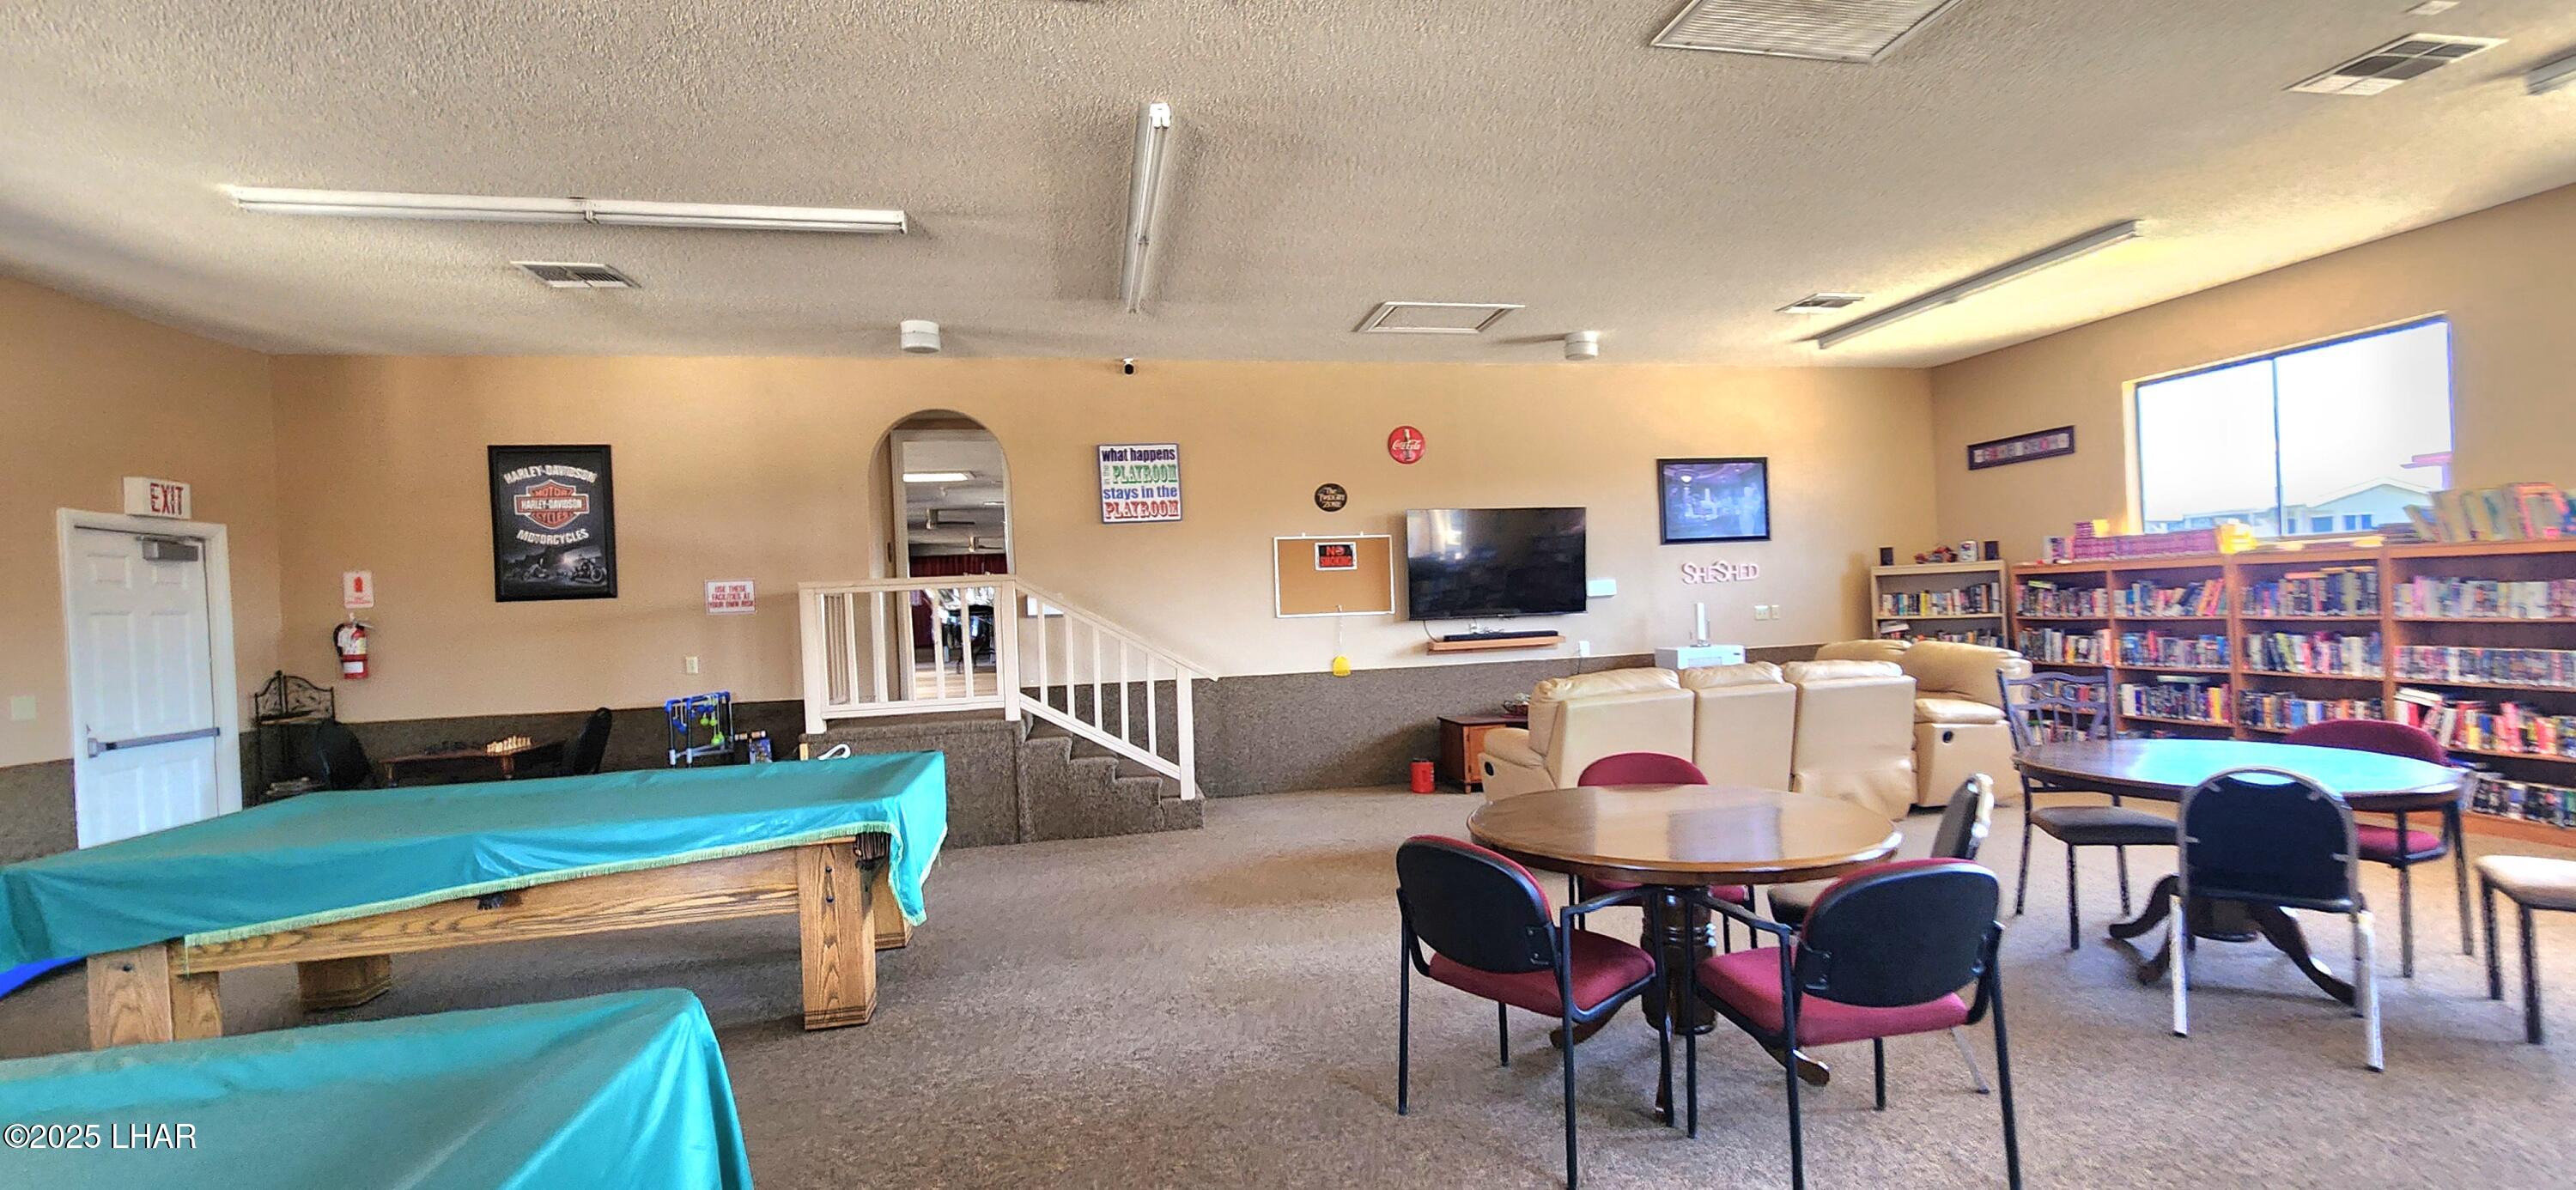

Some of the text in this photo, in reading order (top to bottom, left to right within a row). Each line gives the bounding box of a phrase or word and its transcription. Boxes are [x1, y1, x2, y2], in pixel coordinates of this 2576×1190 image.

[1102, 448, 1176, 463] what happens
[503, 464, 598, 484] HARLEY-DAVIDSON
[1112, 464, 1178, 484] PLAYROOM
[150, 483, 184, 515] EXIT
[534, 486, 573, 497] MOTOR
[1103, 485, 1177, 500] stays in the
[520, 499, 582, 510] HARLEY-DAVIDSON
[1104, 500, 1179, 519] PLAYROOM
[516, 528, 590, 545] MOTORCYCLES
[1326, 545, 1346, 556] NO
